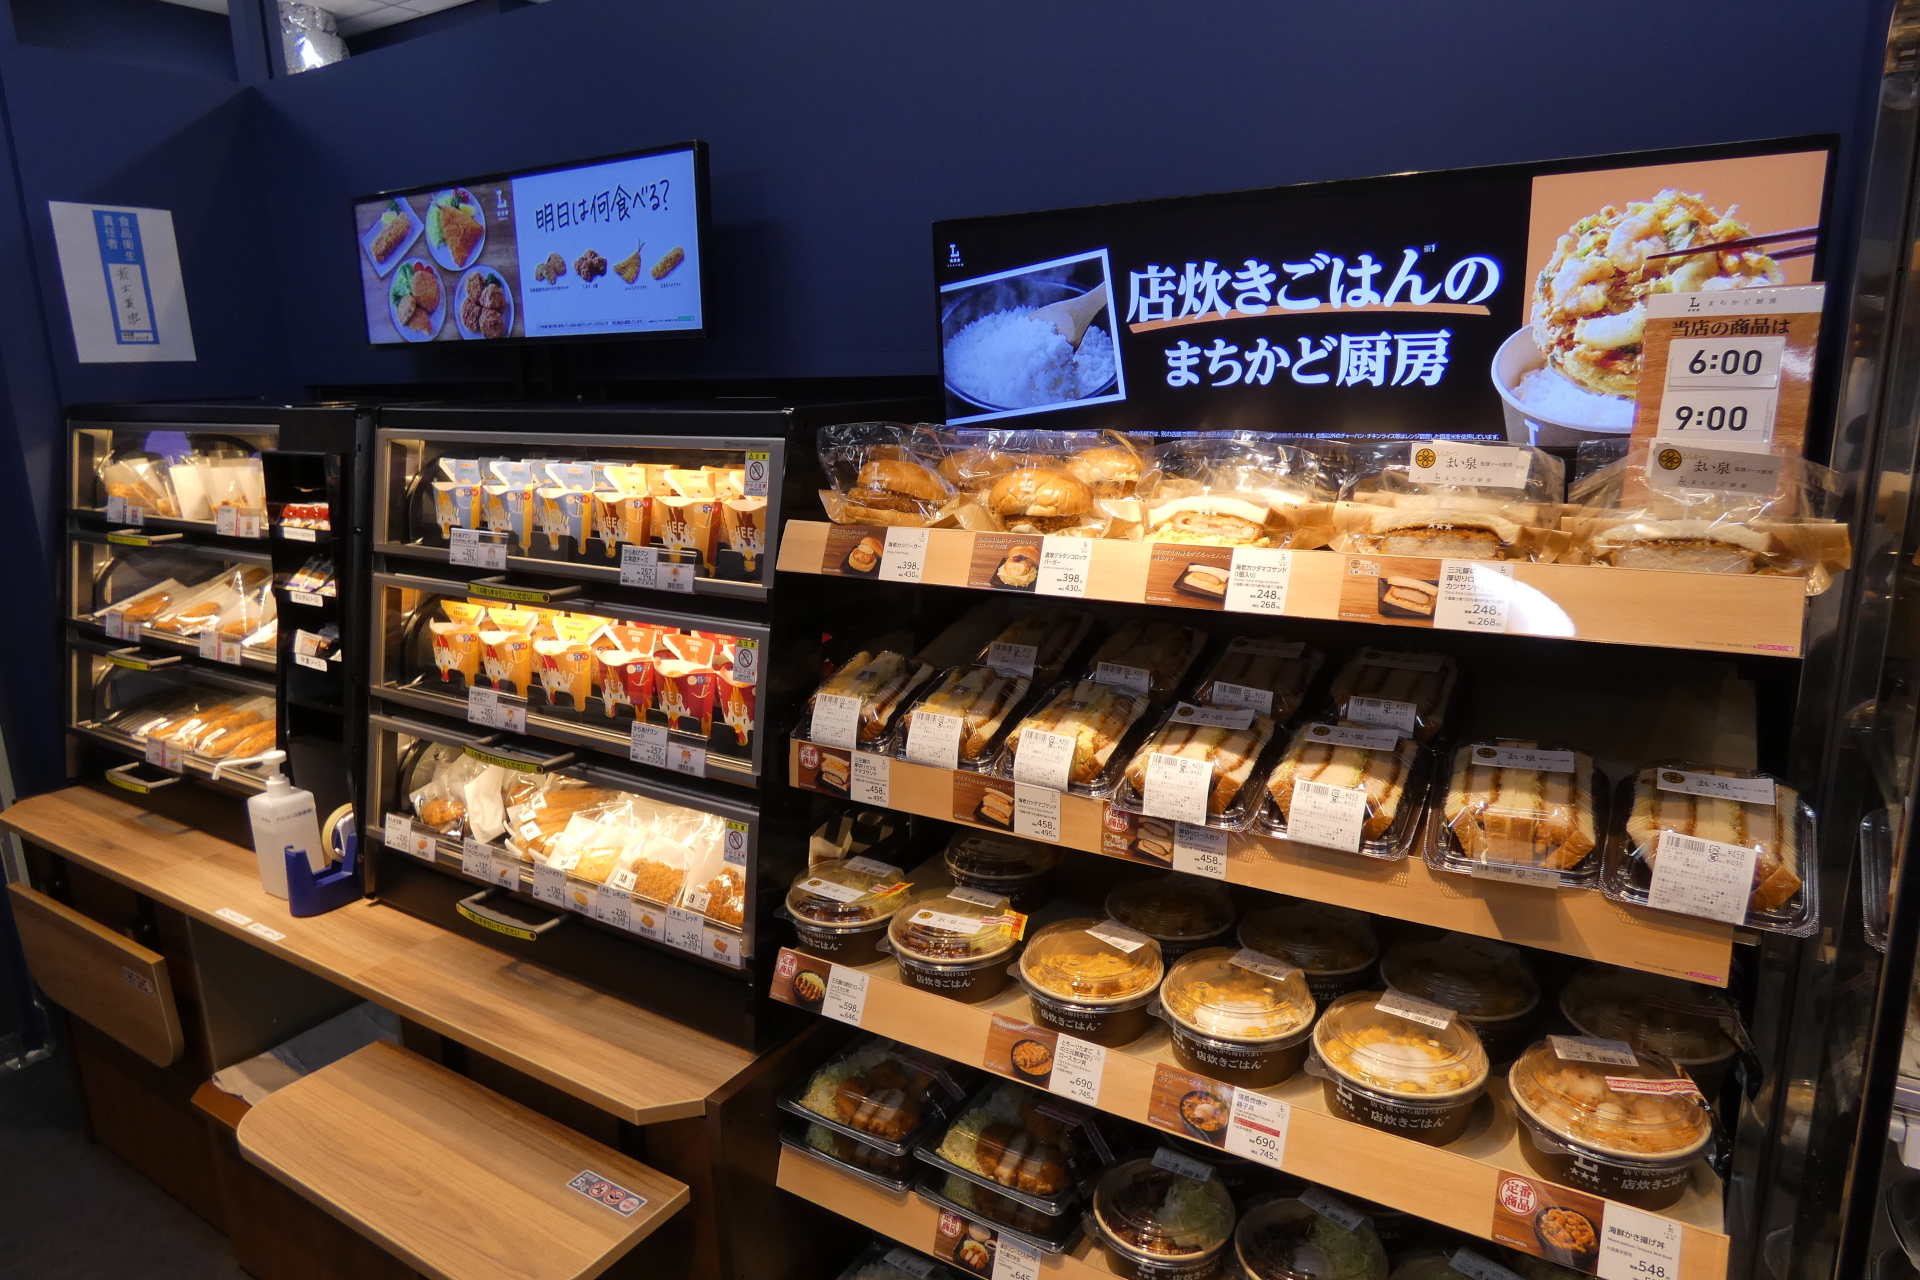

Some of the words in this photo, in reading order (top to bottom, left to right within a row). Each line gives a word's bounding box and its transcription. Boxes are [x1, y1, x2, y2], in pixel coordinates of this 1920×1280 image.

[535, 179, 671, 233] 明日は何食べる?
[118, 216, 136, 262] 食品衛生
[1126, 248, 1502, 322] 店炊きごはんの
[1708, 297, 1778, 307] まちかど厨房
[1671, 317, 1791, 338] 当店の商品は
[1164, 329, 1451, 387] まちかど厨房
[1688, 349, 1763, 376] 6:00
[1675, 405, 1748, 432] 9:00
[1446, 456, 1477, 470] まい泉
[1693, 459, 1730, 475] まい泉
[887, 541, 922, 550] 海老カツバーガー
[623, 548, 649, 557] からあげクン
[1044, 551, 1088, 561] 濃厚グラタンコロッケ
[623, 555, 649, 564] 北海道チーズ
[902, 561, 917, 570] 398
[640, 568, 652, 576] 257
[1235, 563, 1288, 574] 海老カツタマゴサンド
[1063, 573, 1080, 583] 398
[1234, 571, 1257, 579] (1個入り)
[1065, 584, 1079, 592] 430
[1257, 589, 1277, 600] 248
[1260, 600, 1276, 609] 268
[1472, 604, 1497, 616] 248
[1477, 617, 1496, 627] 268
[604, 678, 624, 691] RED
[470, 690, 491, 698] からあげクン
[661, 690, 683, 702] RED
[727, 701, 748, 714] RED
[632, 726, 658, 736] からあげクン
[650, 746, 662, 755] 257
[869, 785, 884, 795] 458
[1018, 797, 1057, 810] 海老カツタマゴサンド
[1037, 819, 1053, 829] 458
[1040, 829, 1053, 837] 495
[1178, 829, 1220, 841] 厚切りロースカツ
[1178, 834, 1194, 842] サンド
[1200, 854, 1219, 865] 458
[1727, 848, 1745, 861] ¥458
[1203, 865, 1219, 874] 495
[1726, 859, 1744, 868] ¥495
[535, 865, 564, 879] ハッシュドポテト
[551, 886, 561, 895] 130
[599, 886, 609, 894] Lチキ
[612, 890, 630, 900] レギュラー
[615, 908, 627, 918] 230
[669, 910, 682, 918] Lチキ
[685, 913, 698, 922] レッド
[686, 931, 699, 942] 240
[843, 1001, 857, 1013] 598
[844, 1012, 856, 1021] 646
[1061, 1040, 1094, 1055] とろーりたまご
[1058, 1052, 1087, 1066] ロースカツ丼
[1059, 1046, 1094, 1062] の三元豚厚切り
[1075, 1077, 1093, 1090] 690
[1078, 1089, 1091, 1099] 745
[1236, 1100, 1255, 1112] 親子丼
[1237, 1093, 1268, 1109] 備長炭焼き
[1255, 1135, 1276, 1150] 690
[1259, 1148, 1274, 1160] 745
[1506, 1181, 1533, 1201] 定番
[1504, 1194, 1531, 1212] 商品
[1607, 1225, 1666, 1250] 海鮮かき揚げ丼
[1637, 1260, 1665, 1278] 548
